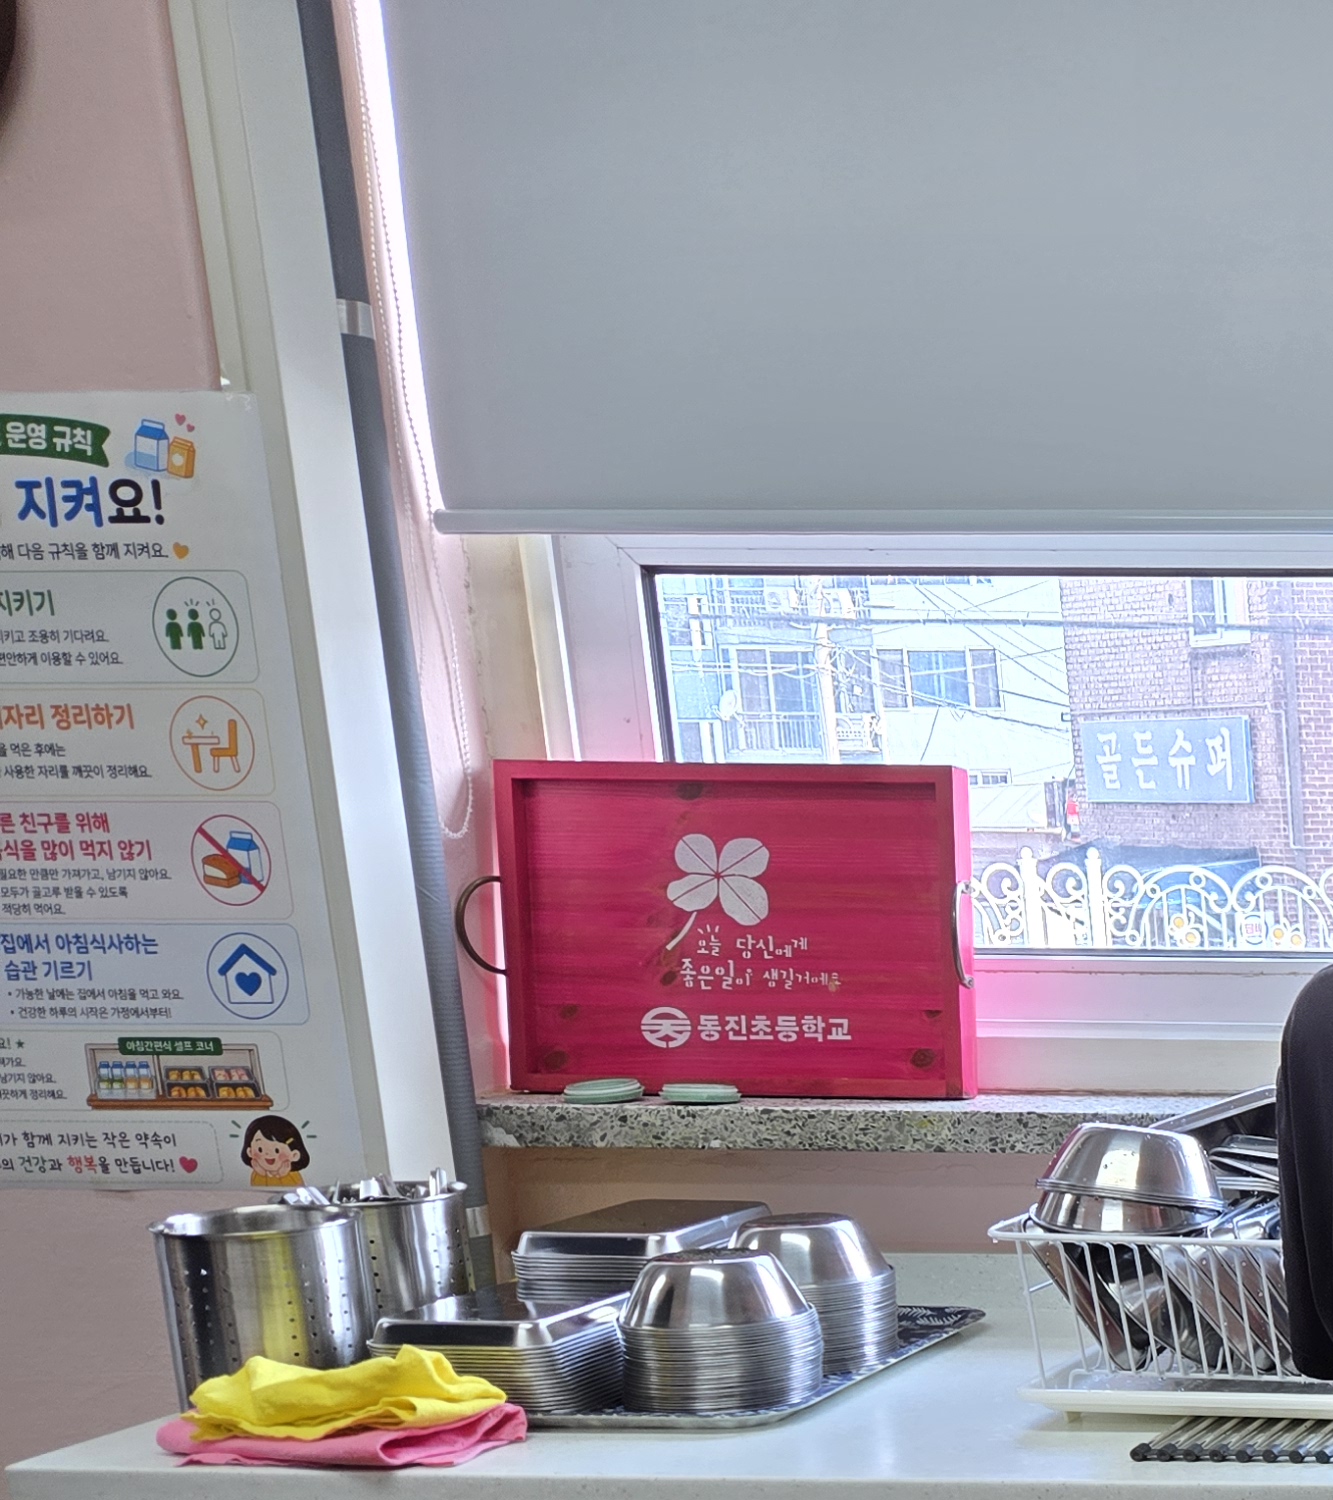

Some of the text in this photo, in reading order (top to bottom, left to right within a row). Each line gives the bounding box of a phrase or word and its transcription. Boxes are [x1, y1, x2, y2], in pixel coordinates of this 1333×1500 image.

[6, 421, 92, 456] 운영 규칙
[15, 476, 165, 528] 지켜요!
[17, 542, 44, 560] 다음
[48, 542, 89, 561] 규칙을
[91, 542, 121, 560] 함께
[27, 629, 61, 644] 조용히
[40, 651, 73, 666] 이용할
[75, 652, 87, 665] 수
[50, 703, 135, 730] 정리하기
[10, 742, 32, 758] 먹은
[34, 742, 66, 757] 후에는
[1095, 727, 1233, 792] 골든슈퍼
[4, 765, 35, 779] 사용한
[37, 765, 70, 779] 자리를
[72, 765, 104, 779] 깨끗이
[19, 812, 71, 834] 친구를
[75, 812, 111, 834] 위해
[0, 839, 152, 862] 식을 많이 먹지 않기
[29, 868, 59, 881] 만큼만
[106, 868, 136, 881] 남기지
[0, 886, 129, 899] 모두가 골고루 받을 수 있도록
[1, 903, 32, 916] 적당히
[0, 933, 159, 955] 집에서 아침식사하는
[697, 934, 808, 959] 오늘 당신에게
[4, 960, 93, 981] 습관 기르기
[15, 988, 44, 1000] 가능한
[45, 988, 75, 1000] 날에는
[77, 988, 105, 1000] 집에서
[107, 988, 137, 1000] 아침을
[139, 988, 160, 1000] 먹고
[17, 1006, 47, 1020] 건강한
[49, 1006, 77, 1019] 하루의
[79, 1006, 109, 1019] 시작은
[697, 1014, 852, 1043] 동진초등학교
[0, 1089, 28, 1100] 끗하게
[21, 1131, 53, 1148] 함께
[58, 1131, 98, 1148] 지키는
[102, 1131, 131, 1149] 작은
[135, 1131, 177, 1149] 약속이
[18, 1157, 63, 1173] 건강과
[66, 1156, 110, 1174] 행복을
[114, 1157, 175, 1173] 만듭니다!
